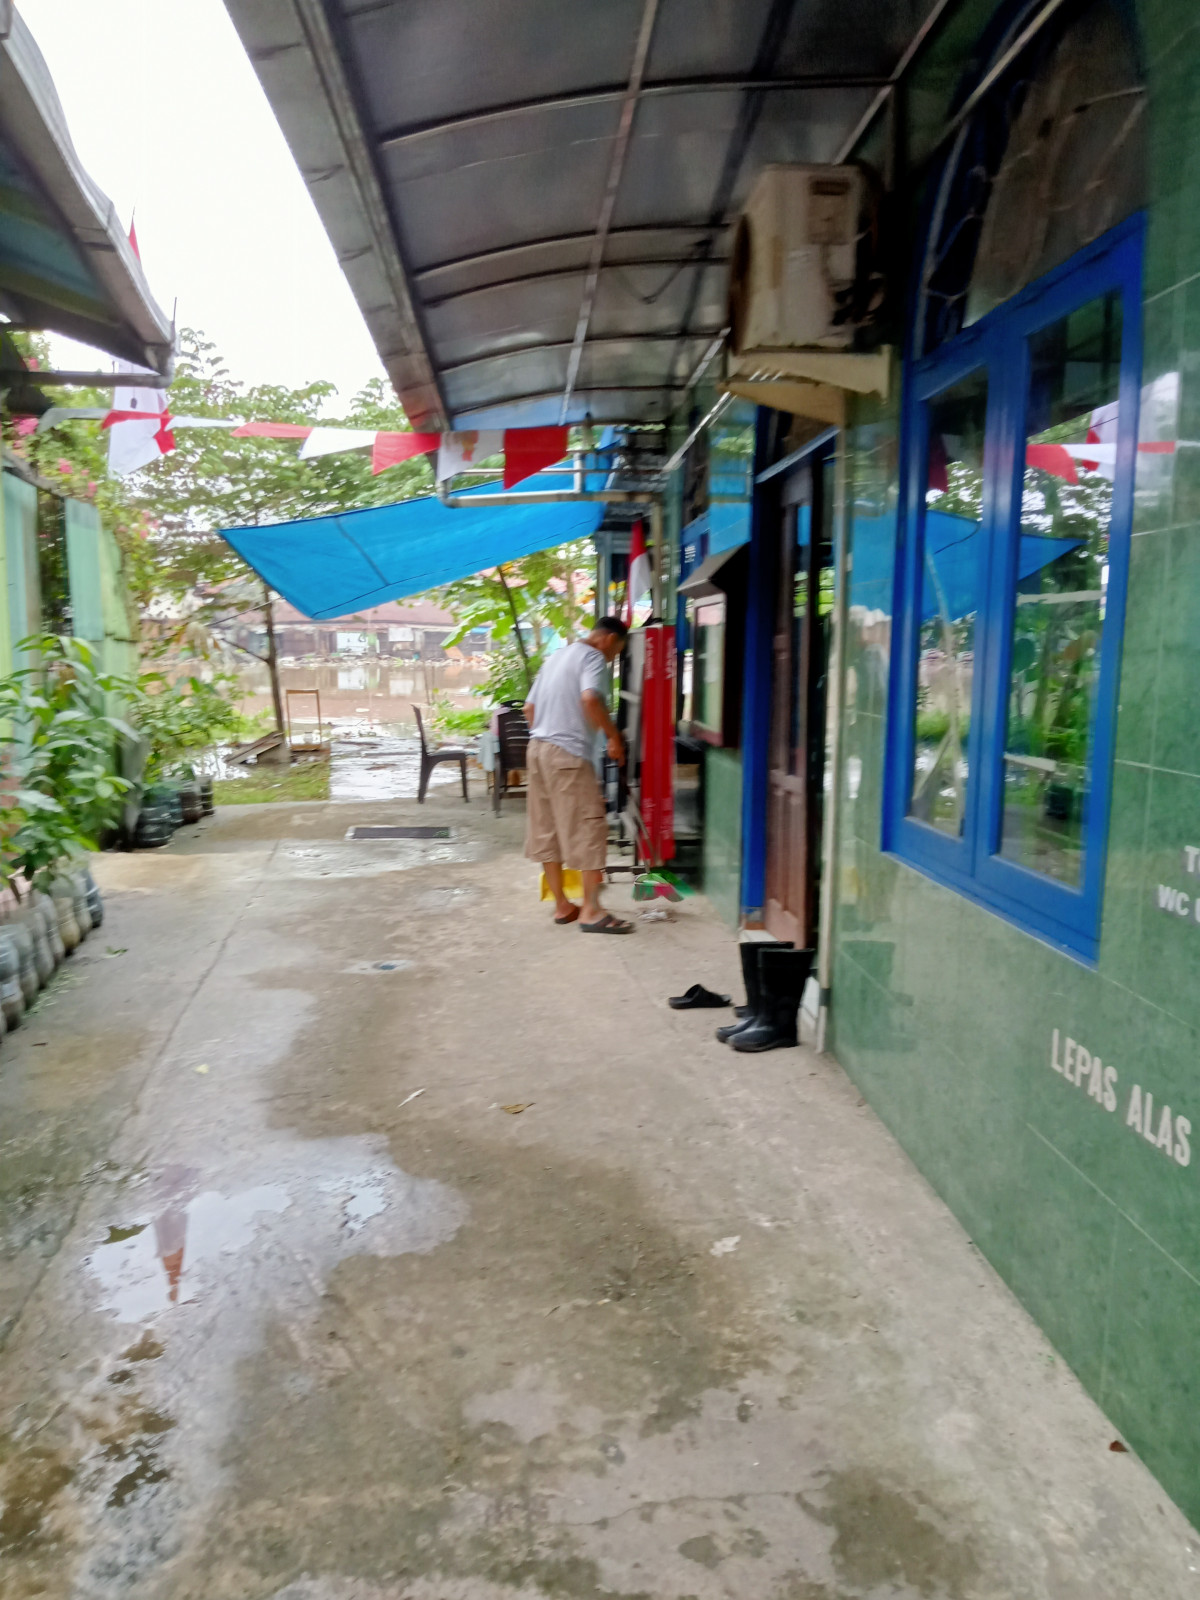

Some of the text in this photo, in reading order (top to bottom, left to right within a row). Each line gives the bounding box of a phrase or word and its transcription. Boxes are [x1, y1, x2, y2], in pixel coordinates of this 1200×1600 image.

[1184, 845, 1200, 873] T
[1158, 884, 1190, 915] WC
[1051, 1028, 1192, 1167] LEPAS ALAS
